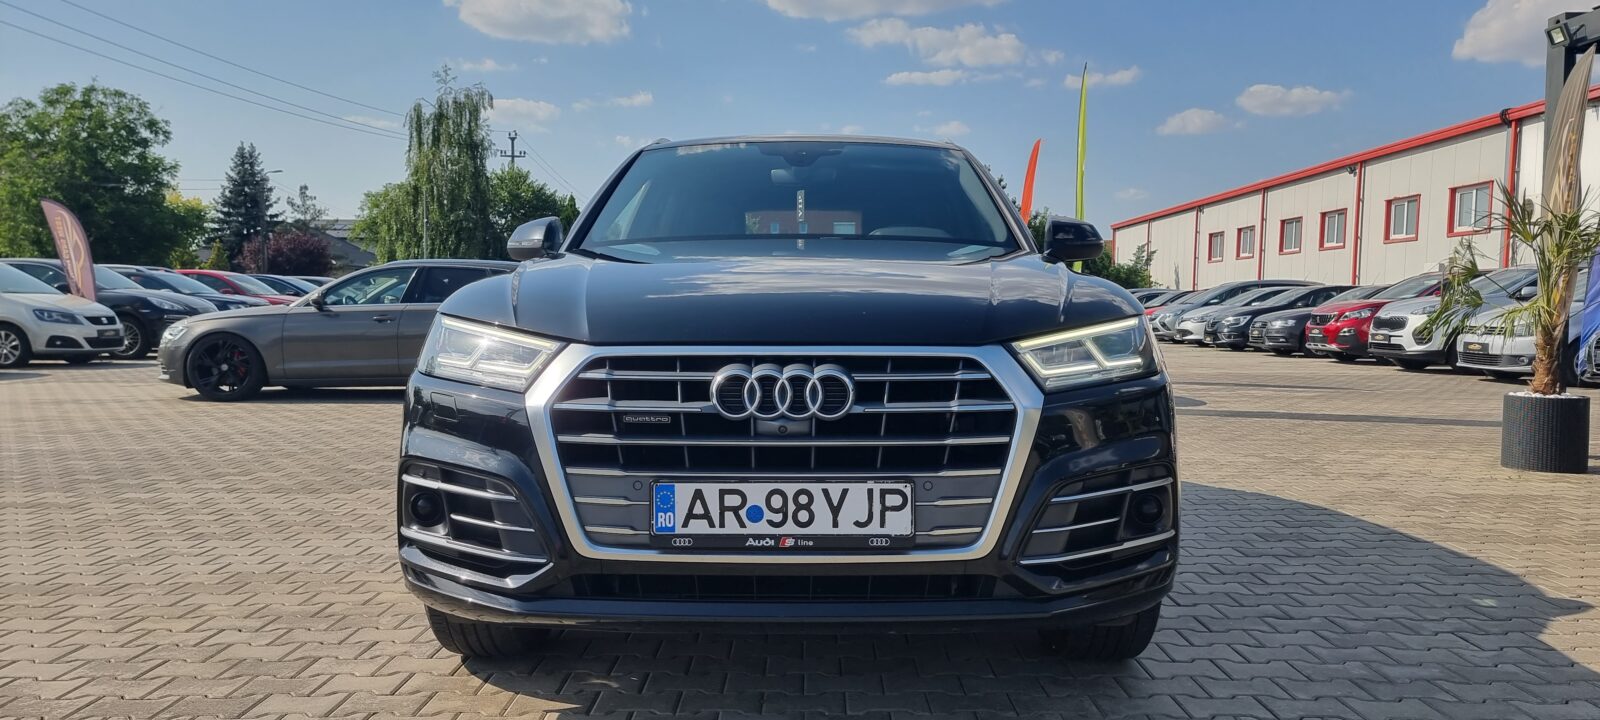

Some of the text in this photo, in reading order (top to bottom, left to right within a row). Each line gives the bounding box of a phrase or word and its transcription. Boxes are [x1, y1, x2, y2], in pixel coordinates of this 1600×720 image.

[681, 487, 909, 528] AR 98 YJP
[657, 512, 674, 528] RO
[745, 537, 775, 546] Audi
